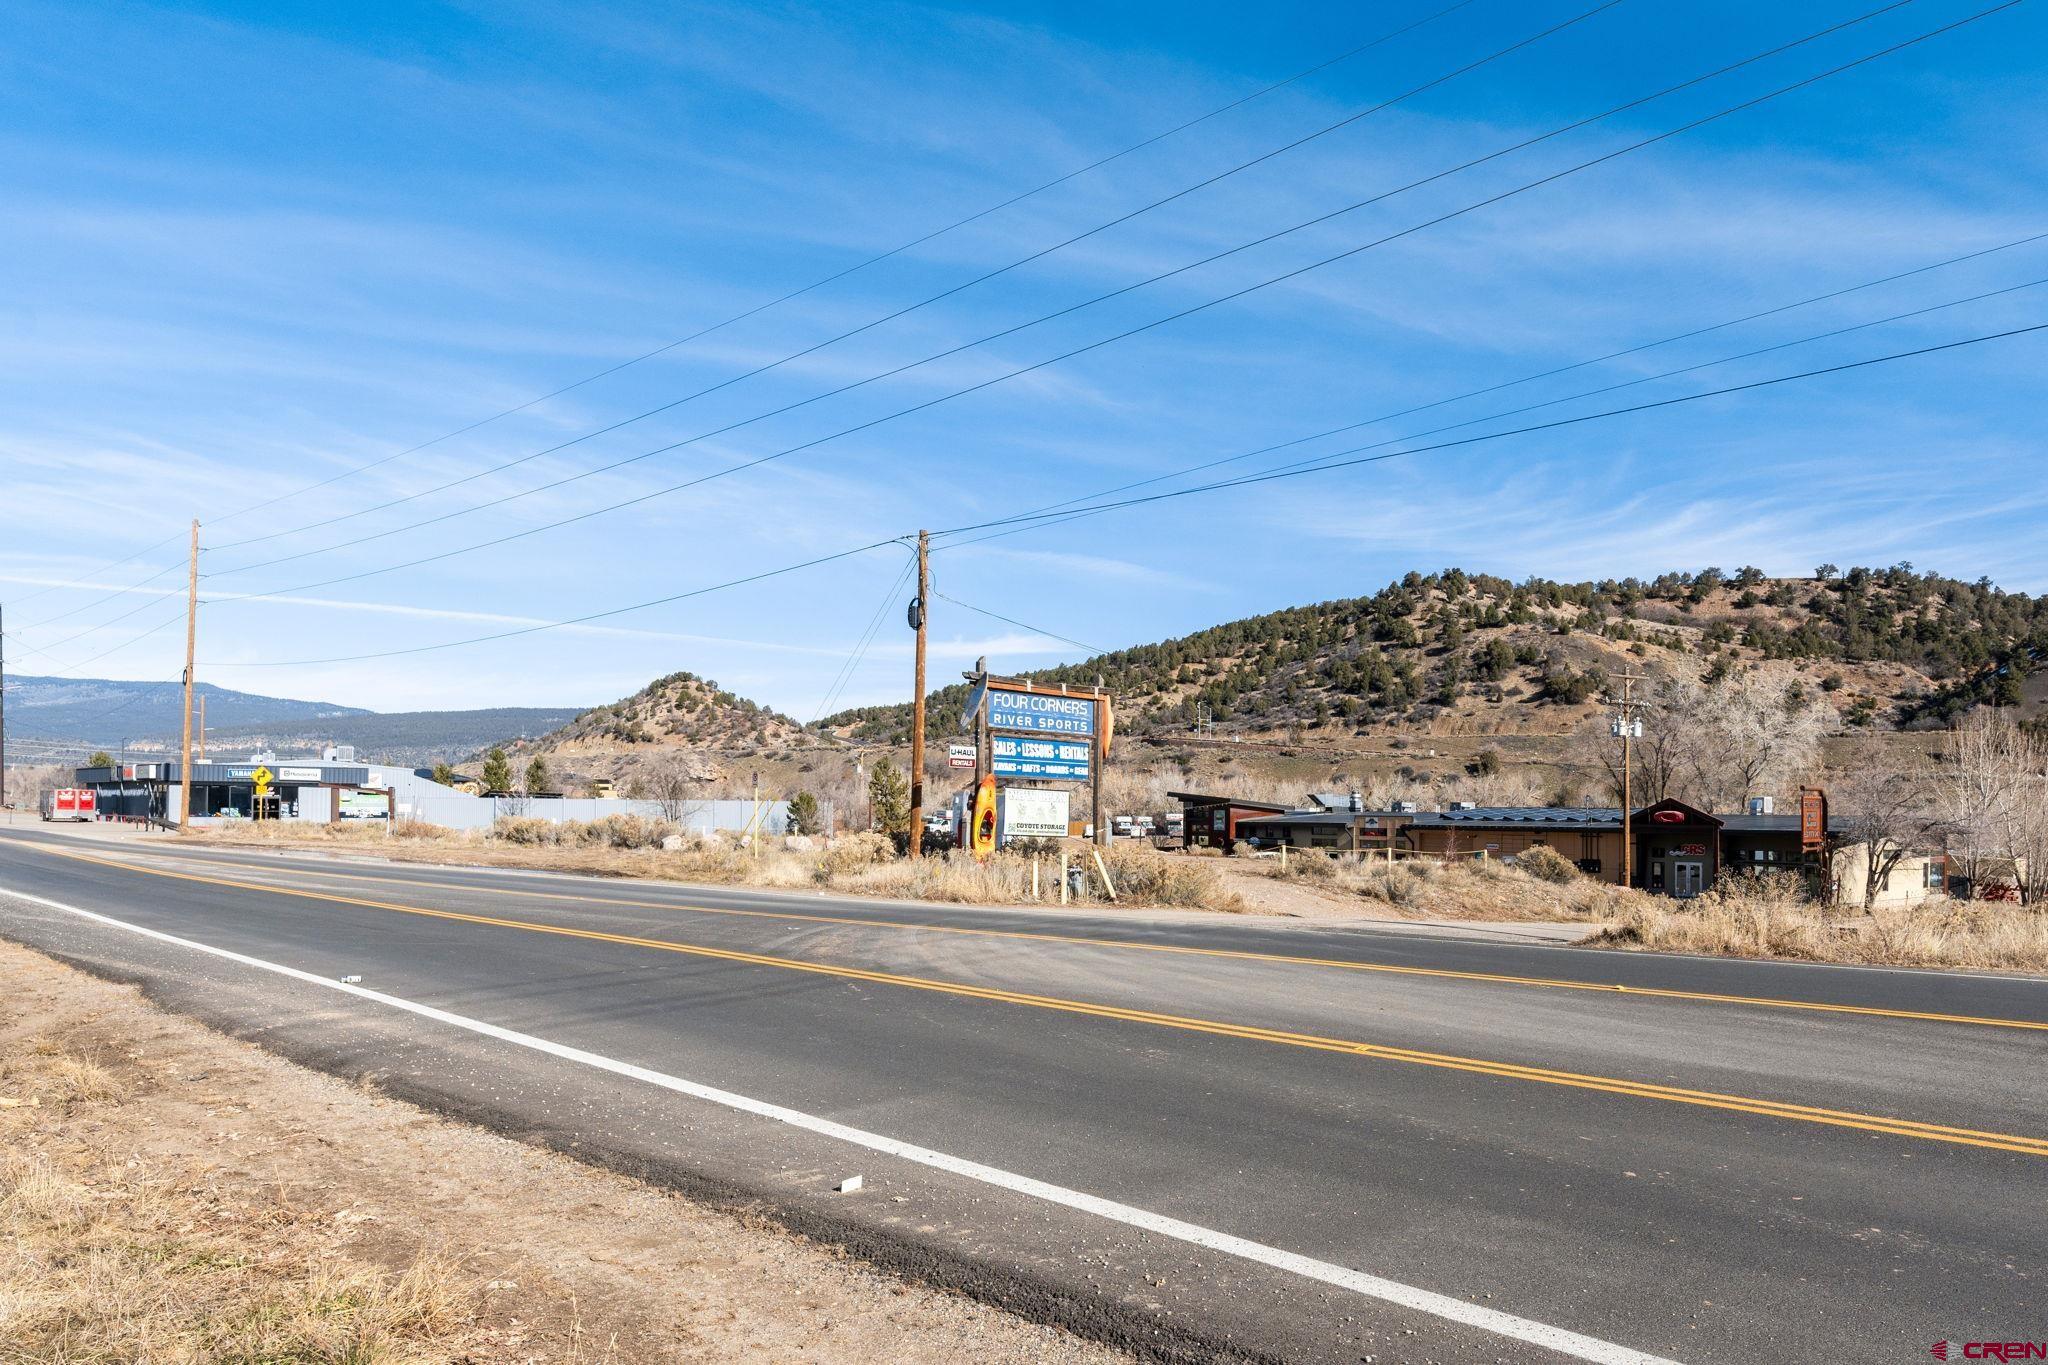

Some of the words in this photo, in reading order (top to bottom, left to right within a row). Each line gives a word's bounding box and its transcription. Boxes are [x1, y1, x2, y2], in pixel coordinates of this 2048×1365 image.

[993, 693, 1028, 711] FOUR
[1030, 696, 1088, 716] CORNERS
[993, 714, 1033, 727] RIVER
[1038, 717, 1088, 732] SPORTS
[950, 748, 975, 757] U-HAUL
[993, 740, 1017, 757] SALES
[1021, 742, 1055, 759] LESSONS
[1059, 745, 1089, 761] RENTALS
[951, 759, 973, 767] RENTALS
[1021, 763, 1041, 773] RAFTS
[1016, 822, 1039, 830] COYOTE
[1040, 823, 1066, 831] STORAGE
